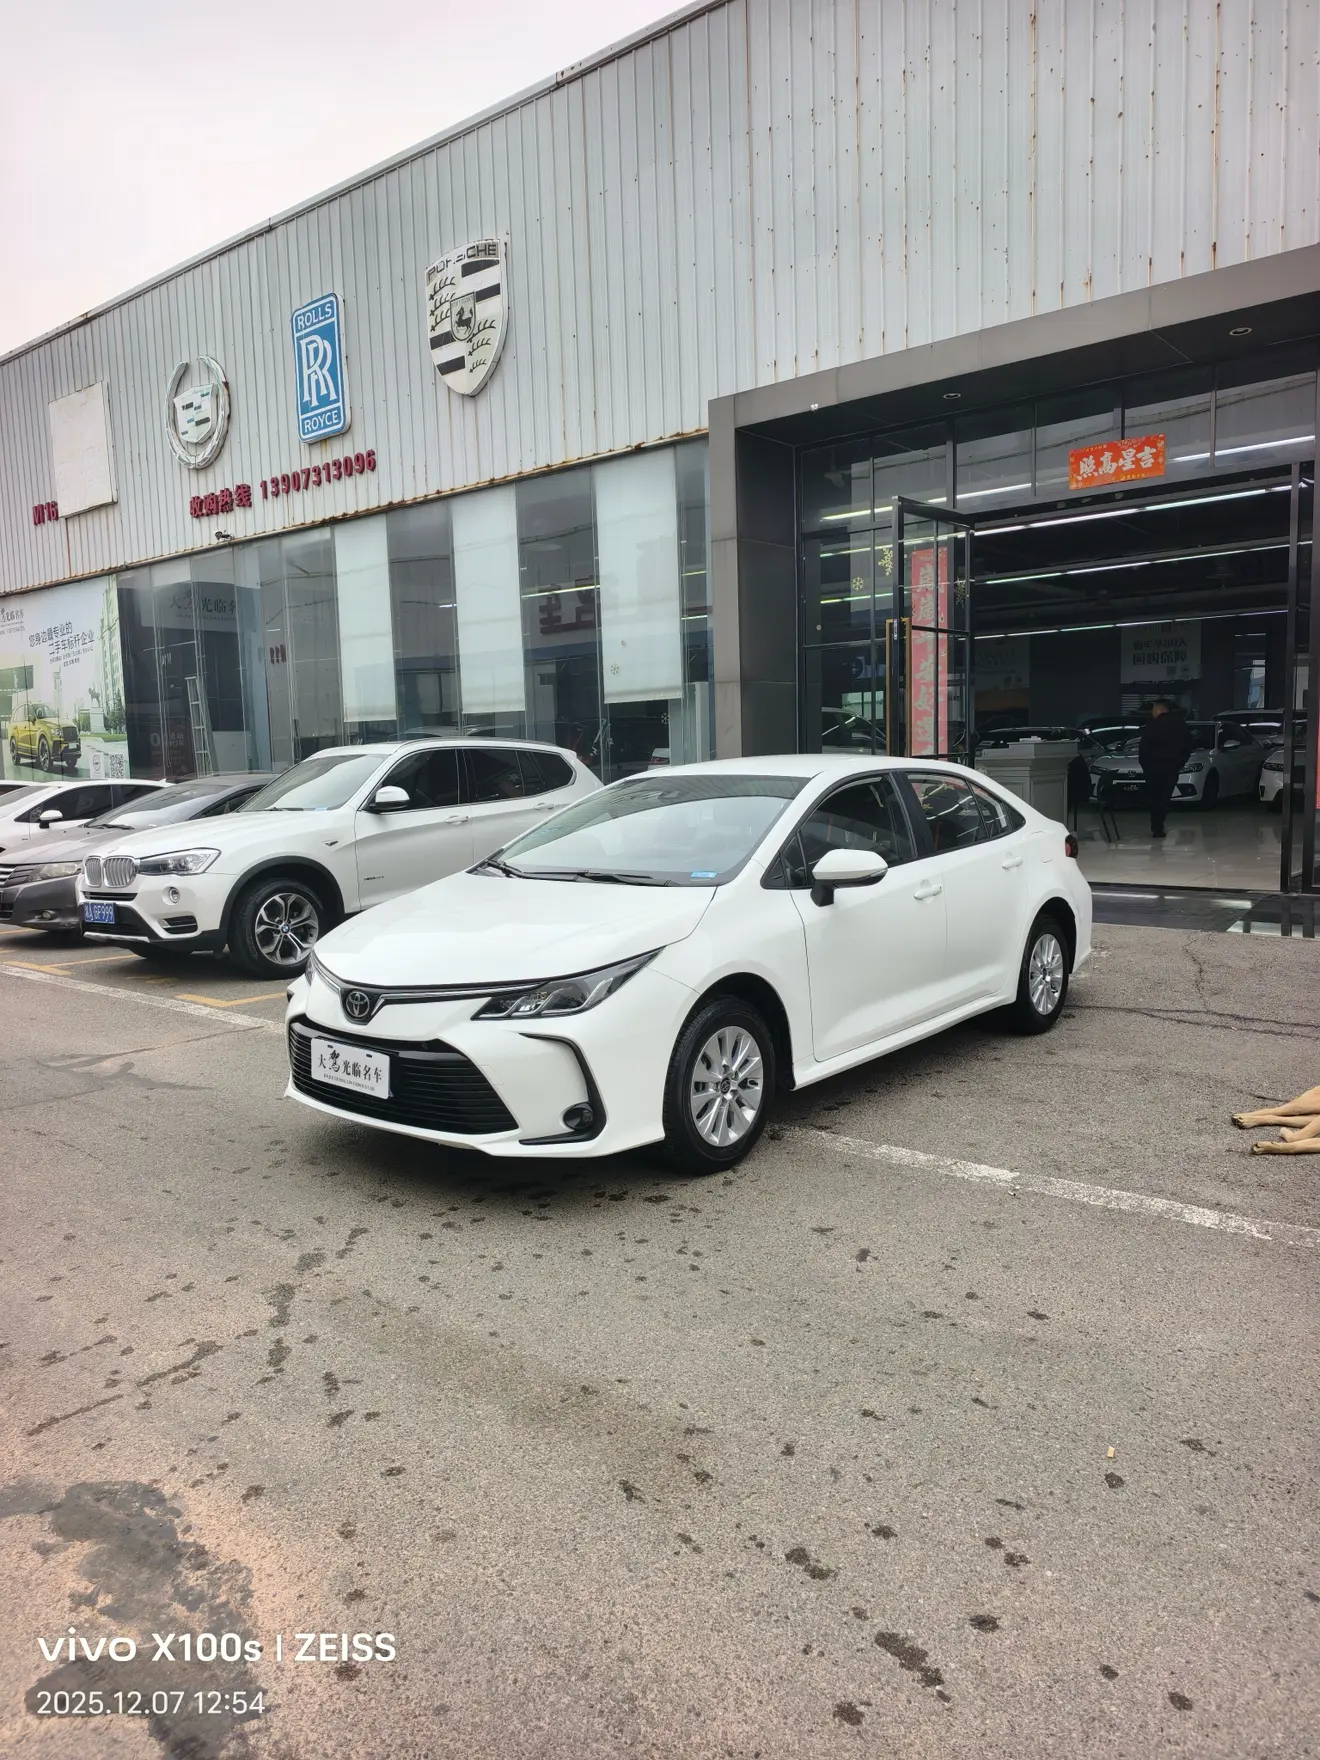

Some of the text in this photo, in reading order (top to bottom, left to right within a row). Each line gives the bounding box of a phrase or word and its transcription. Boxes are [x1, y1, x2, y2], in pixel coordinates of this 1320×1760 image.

[297, 303, 332, 330] ROLLS
[304, 410, 339, 433] ROYCE
[190, 450, 376, 518] 收购热线 13907313096
[29, 620, 73, 648] 您身边最专业的
[49, 629, 95, 655] 二手车标杆企业
[318, 1049, 383, 1084] 大驾光临名车
